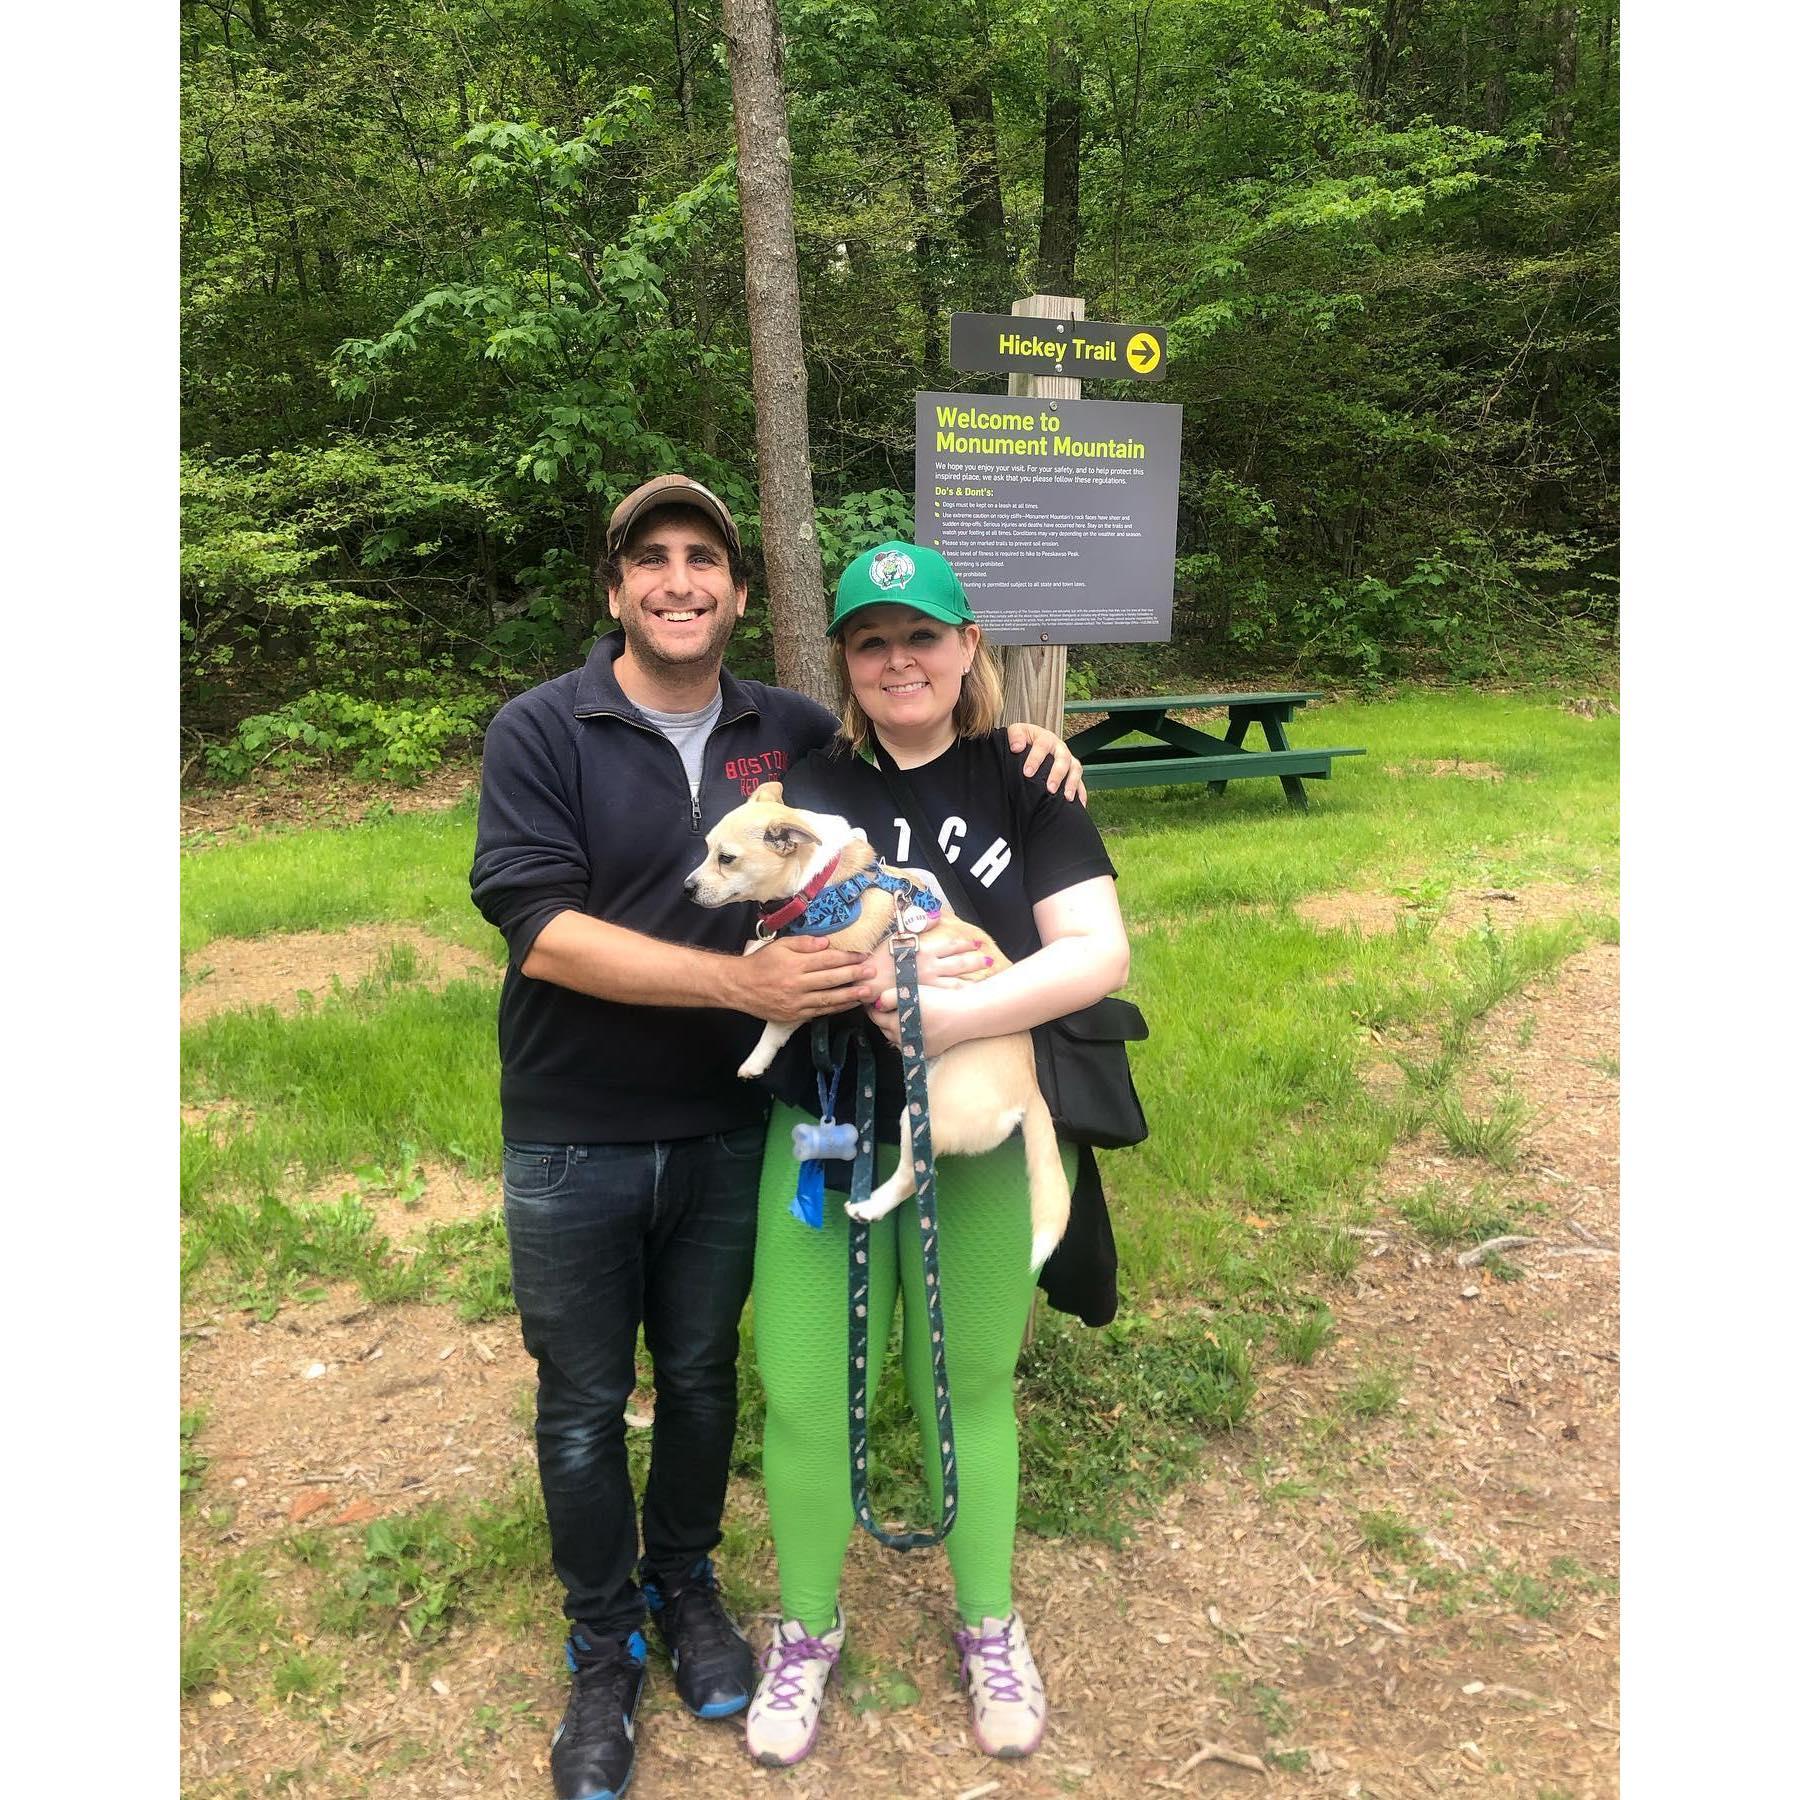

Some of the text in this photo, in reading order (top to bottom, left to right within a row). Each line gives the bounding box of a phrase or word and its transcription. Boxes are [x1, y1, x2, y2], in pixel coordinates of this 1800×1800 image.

[999, 334, 1117, 362] Hickey Trail
[936, 406, 1060, 433] Welcome to
[936, 432, 1145, 459] Monument Mountain
[935, 462, 946, 470] We
[947, 462, 963, 472] hope
[964, 464, 977, 472] you
[977, 463, 995, 473] enjoy
[995, 465, 1010, 473] your
[1027, 464, 1038, 472] For
[1039, 466, 1052, 475] your
[1076, 466, 1087, 474] and
[1088, 466, 1094, 474] to
[1096, 466, 1109, 476] help
[1110, 467, 1132, 477] protect
[1133, 467, 1144, 476] this
[935, 472, 961, 482] inspired
[993, 473, 1004, 481] ask
[1005, 474, 1019, 482] that
[1020, 475, 1031, 484] you
[1032, 475, 1053, 484] please
[1054, 475, 1073, 483] follow
[1092, 477, 1126, 486] regulations.
[935, 487, 994, 496] Do's & Dont's:
[976, 502, 987, 510] kept
